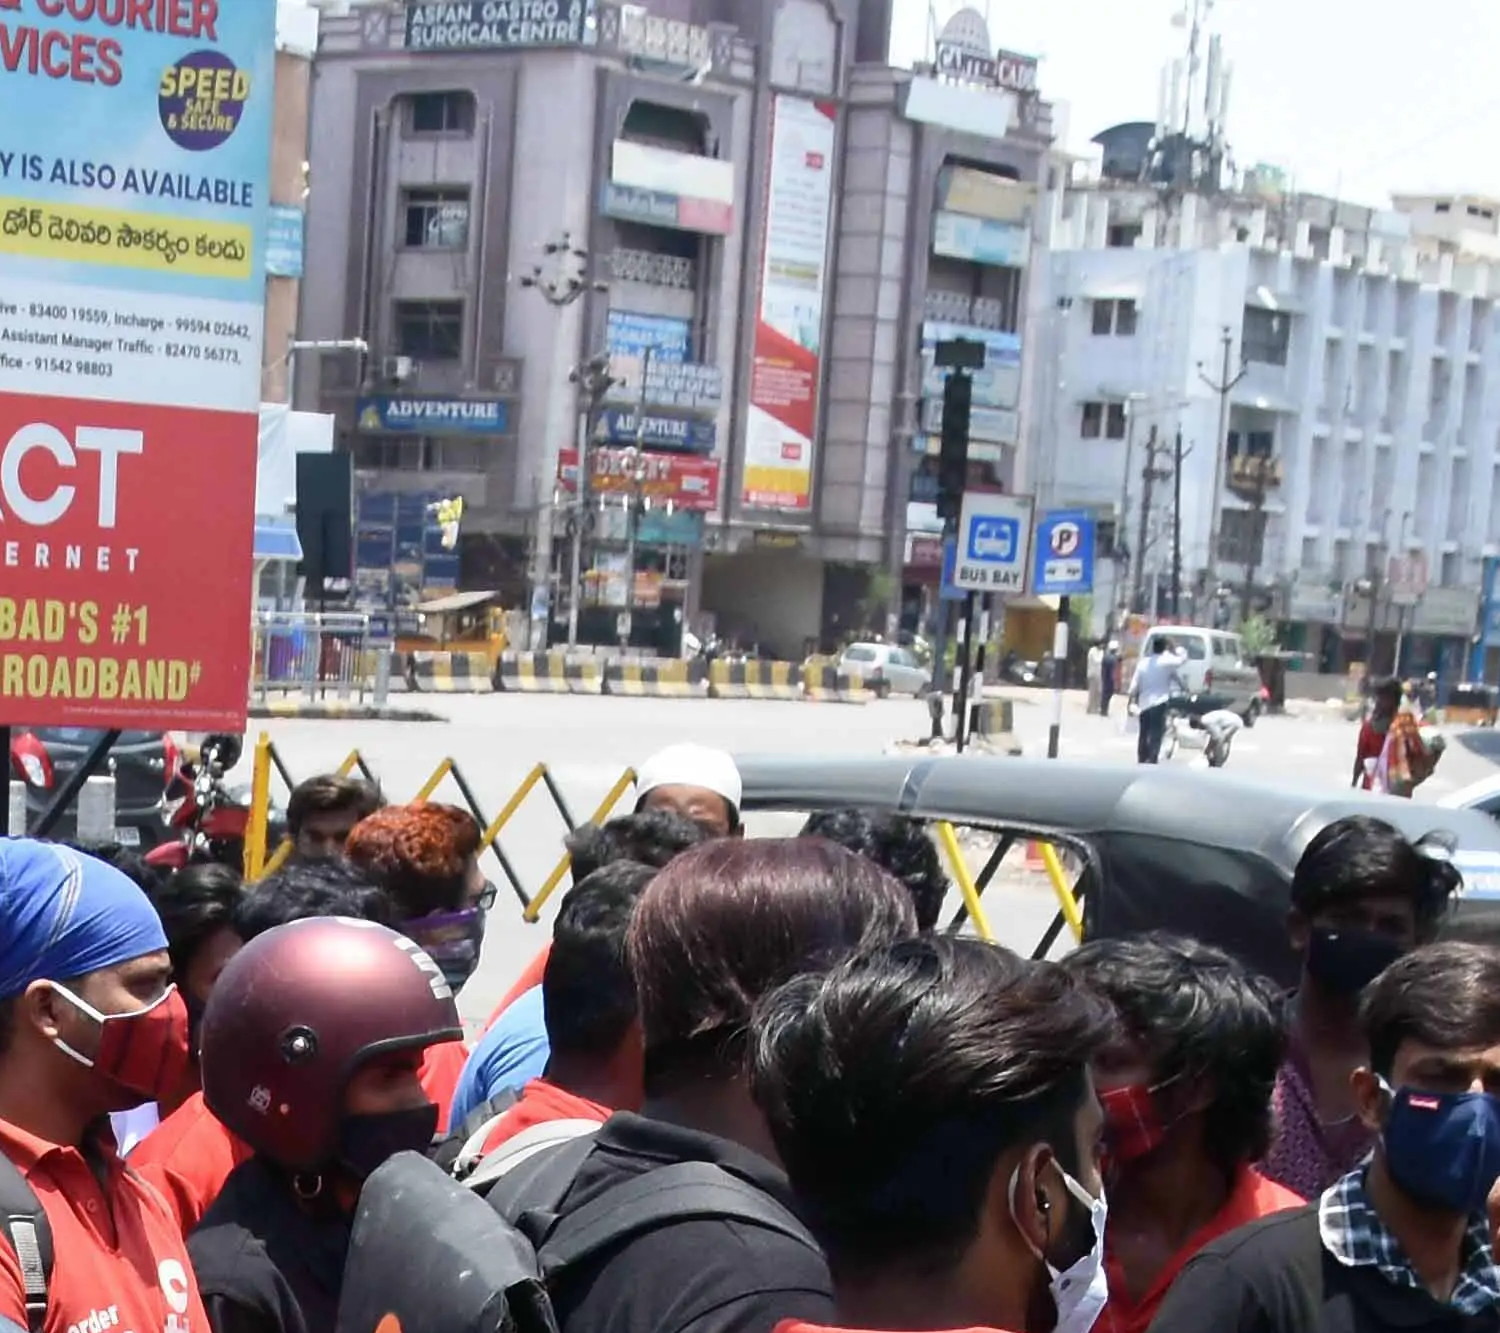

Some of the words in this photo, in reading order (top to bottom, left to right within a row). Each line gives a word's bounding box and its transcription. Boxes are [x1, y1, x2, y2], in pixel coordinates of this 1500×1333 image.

[481, 0, 559, 22] GASTRO
[410, 20, 501, 46] SURGICAL
[507, 18, 580, 42] CENTRE
[158, 66, 250, 100] SPEED
[185, 98, 220, 115] SAFE
[181, 112, 234, 132] SECURE
[20, 155, 43, 181] IS
[49, 159, 116, 189] ALSO
[121, 168, 254, 208] AVAILABLE
[28, 301, 68, 321] 83400
[71, 306, 111, 327] 19559,
[113, 309, 166, 331] Incharge
[174, 315, 211, 335] 99594
[212, 320, 252, 340] 02642,
[0, 326, 59, 347] Assistant
[61, 332, 114, 355] Manager
[116, 336, 154, 356] Traffic
[164, 341, 202, 361] 82470
[203, 345, 242, 366] 56373,
[34, 356, 73, 375] 91542
[75, 359, 113, 379] 98803
[386, 401, 498, 418] ADVENTURE
[615, 414, 689, 437] ADENTURE
[959, 566, 989, 581] BUS
[992, 569, 1020, 585] BAY
[111, 603, 149, 646] #1
